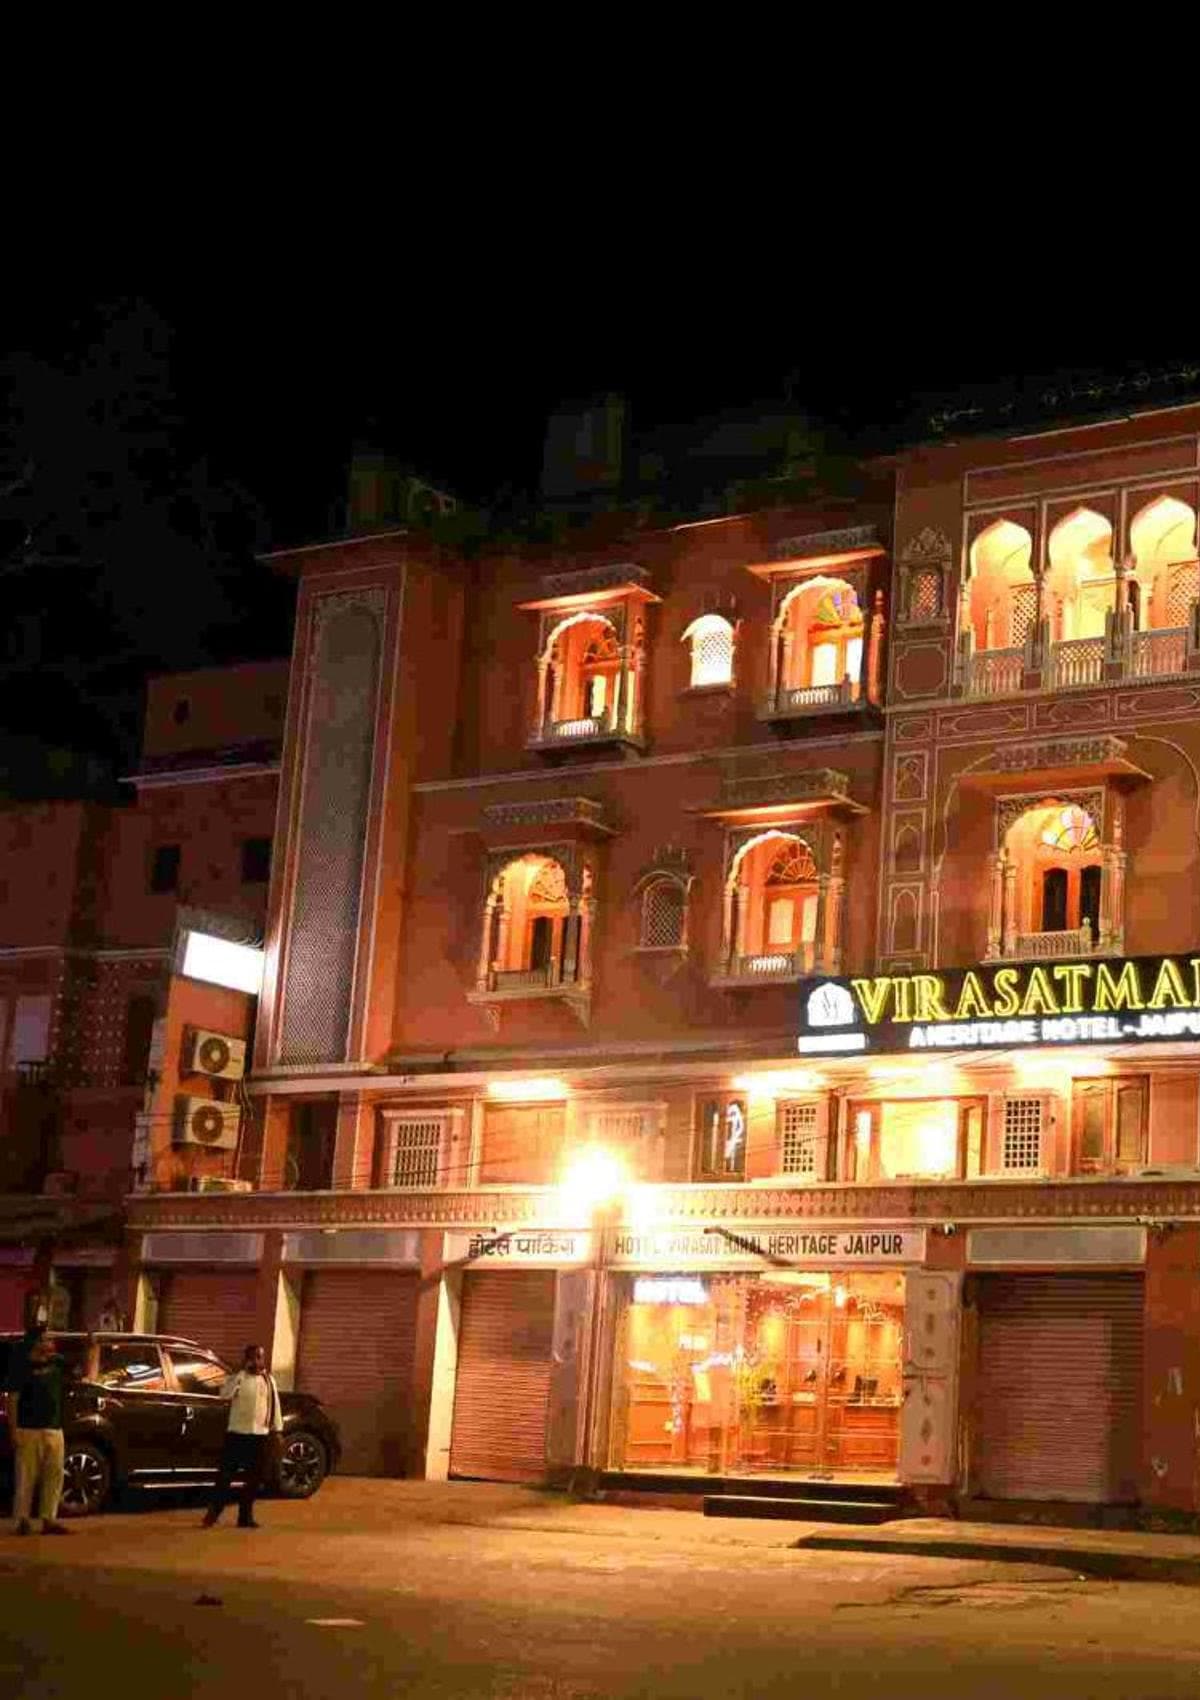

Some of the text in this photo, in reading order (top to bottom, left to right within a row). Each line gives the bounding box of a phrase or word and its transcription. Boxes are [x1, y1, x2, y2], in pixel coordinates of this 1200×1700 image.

[926, 1020, 1037, 1046] HERITAGE
[768, 1235, 836, 1255] HERITAGE
[844, 1234, 903, 1255] JAIPUR
